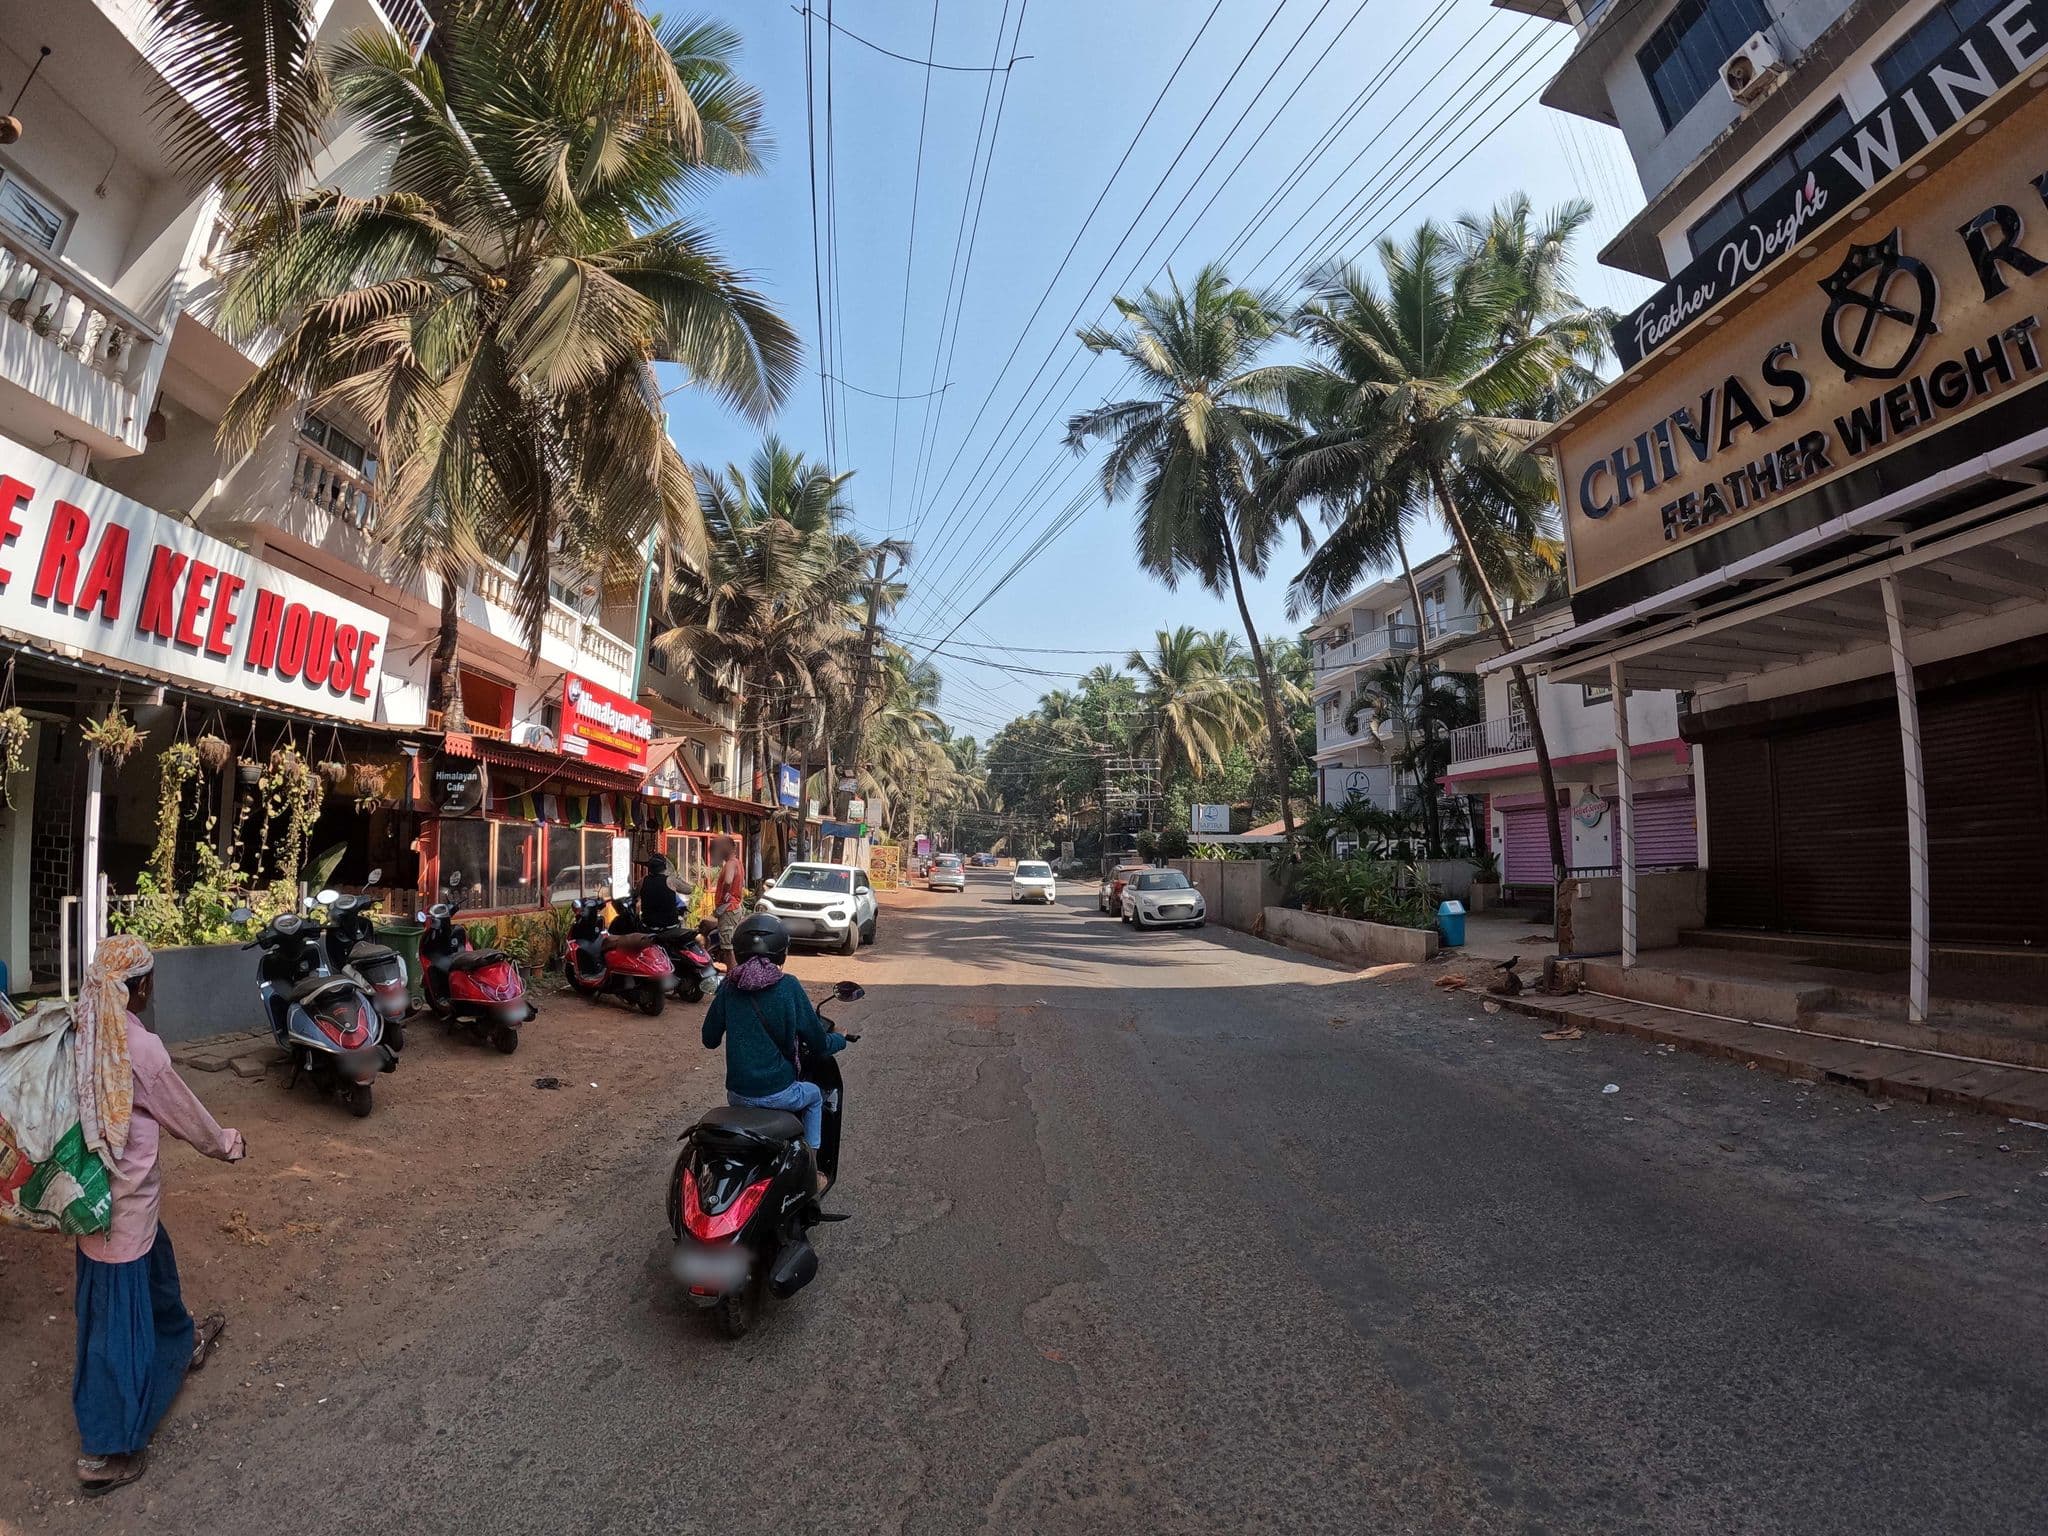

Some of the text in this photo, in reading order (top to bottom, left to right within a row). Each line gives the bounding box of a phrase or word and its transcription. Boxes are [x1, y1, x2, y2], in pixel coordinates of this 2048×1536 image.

[1633, 282, 1715, 358] Feather
[1718, 172, 1827, 288] Weight
[1579, 342, 1809, 520] CHIVAS
[1660, 315, 2041, 541] FEATHER WEIGHT
[34, 499, 129, 620] RA
[138, 544, 246, 656] KEE
[246, 588, 380, 699] HOUSE
[436, 771, 478, 783] Himalayan
[446, 782, 465, 792] Cafe
[576, 689, 633, 733] Himalayan
